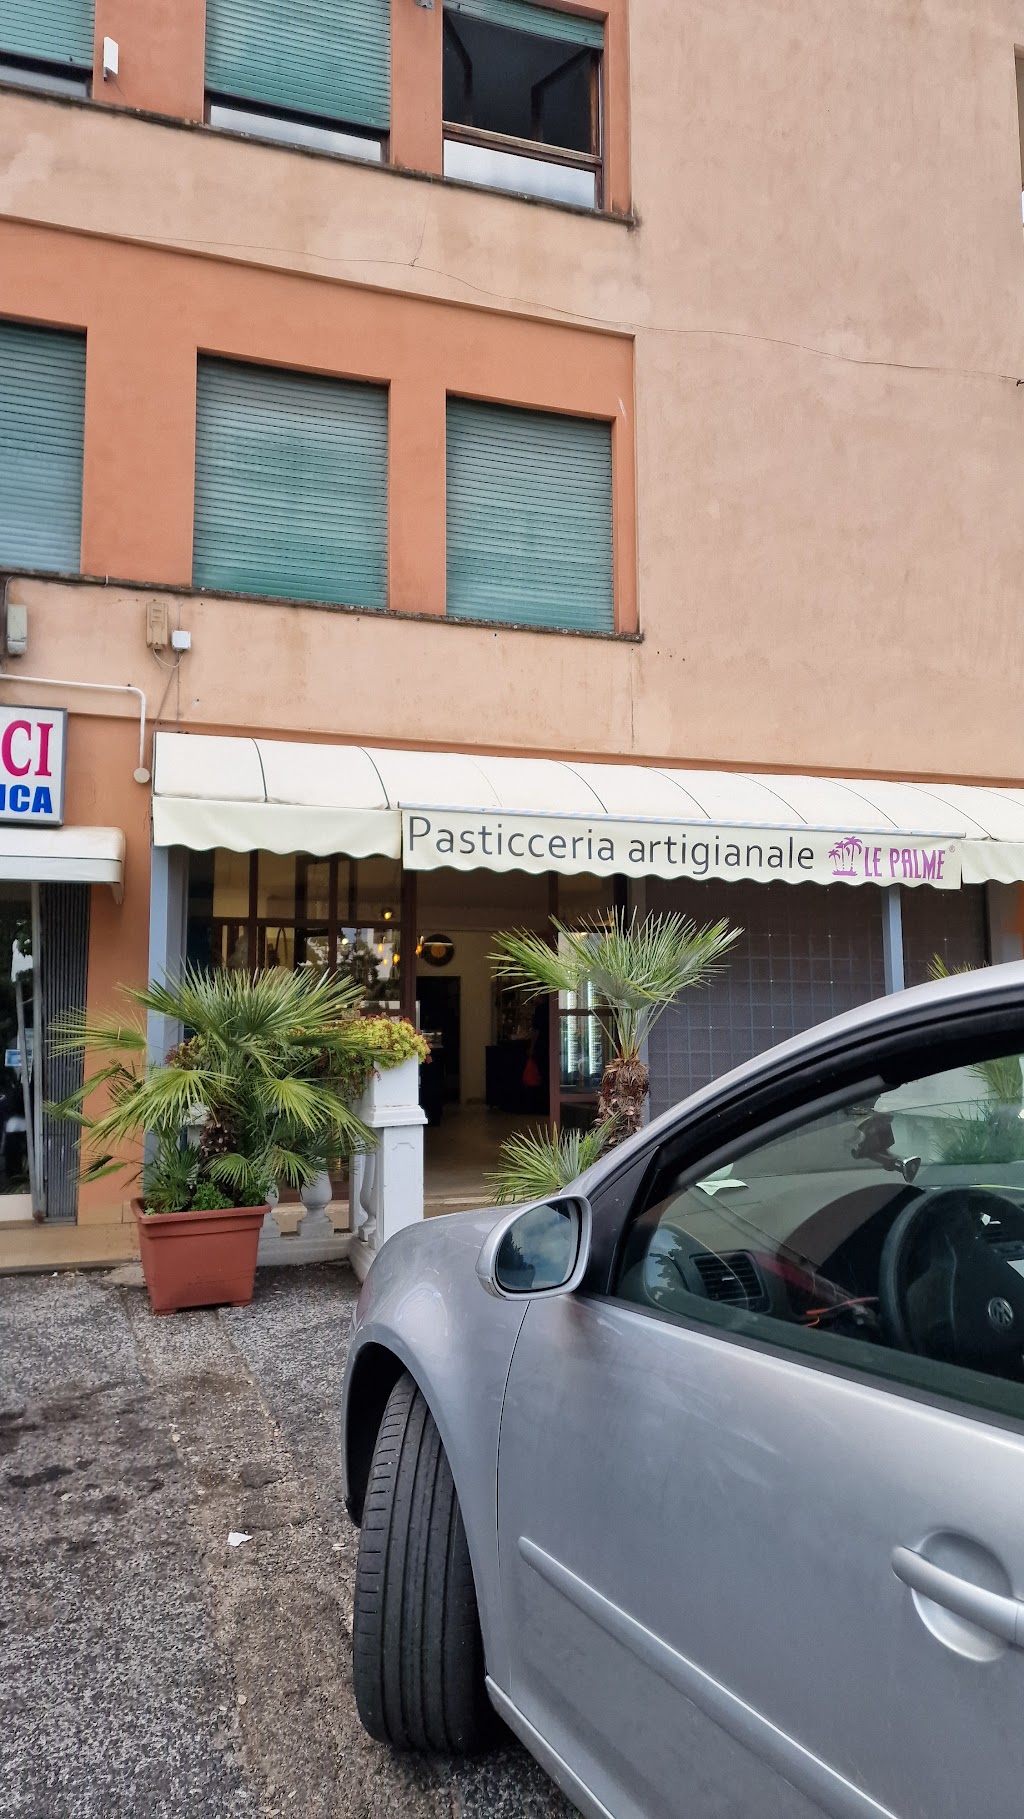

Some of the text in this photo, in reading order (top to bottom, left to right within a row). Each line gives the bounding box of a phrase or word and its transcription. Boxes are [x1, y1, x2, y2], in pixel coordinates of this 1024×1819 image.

[1, 720, 54, 777] CI
[408, 815, 814, 875] Pasticceria artigianale
[864, 846, 946, 880] LE PALME
